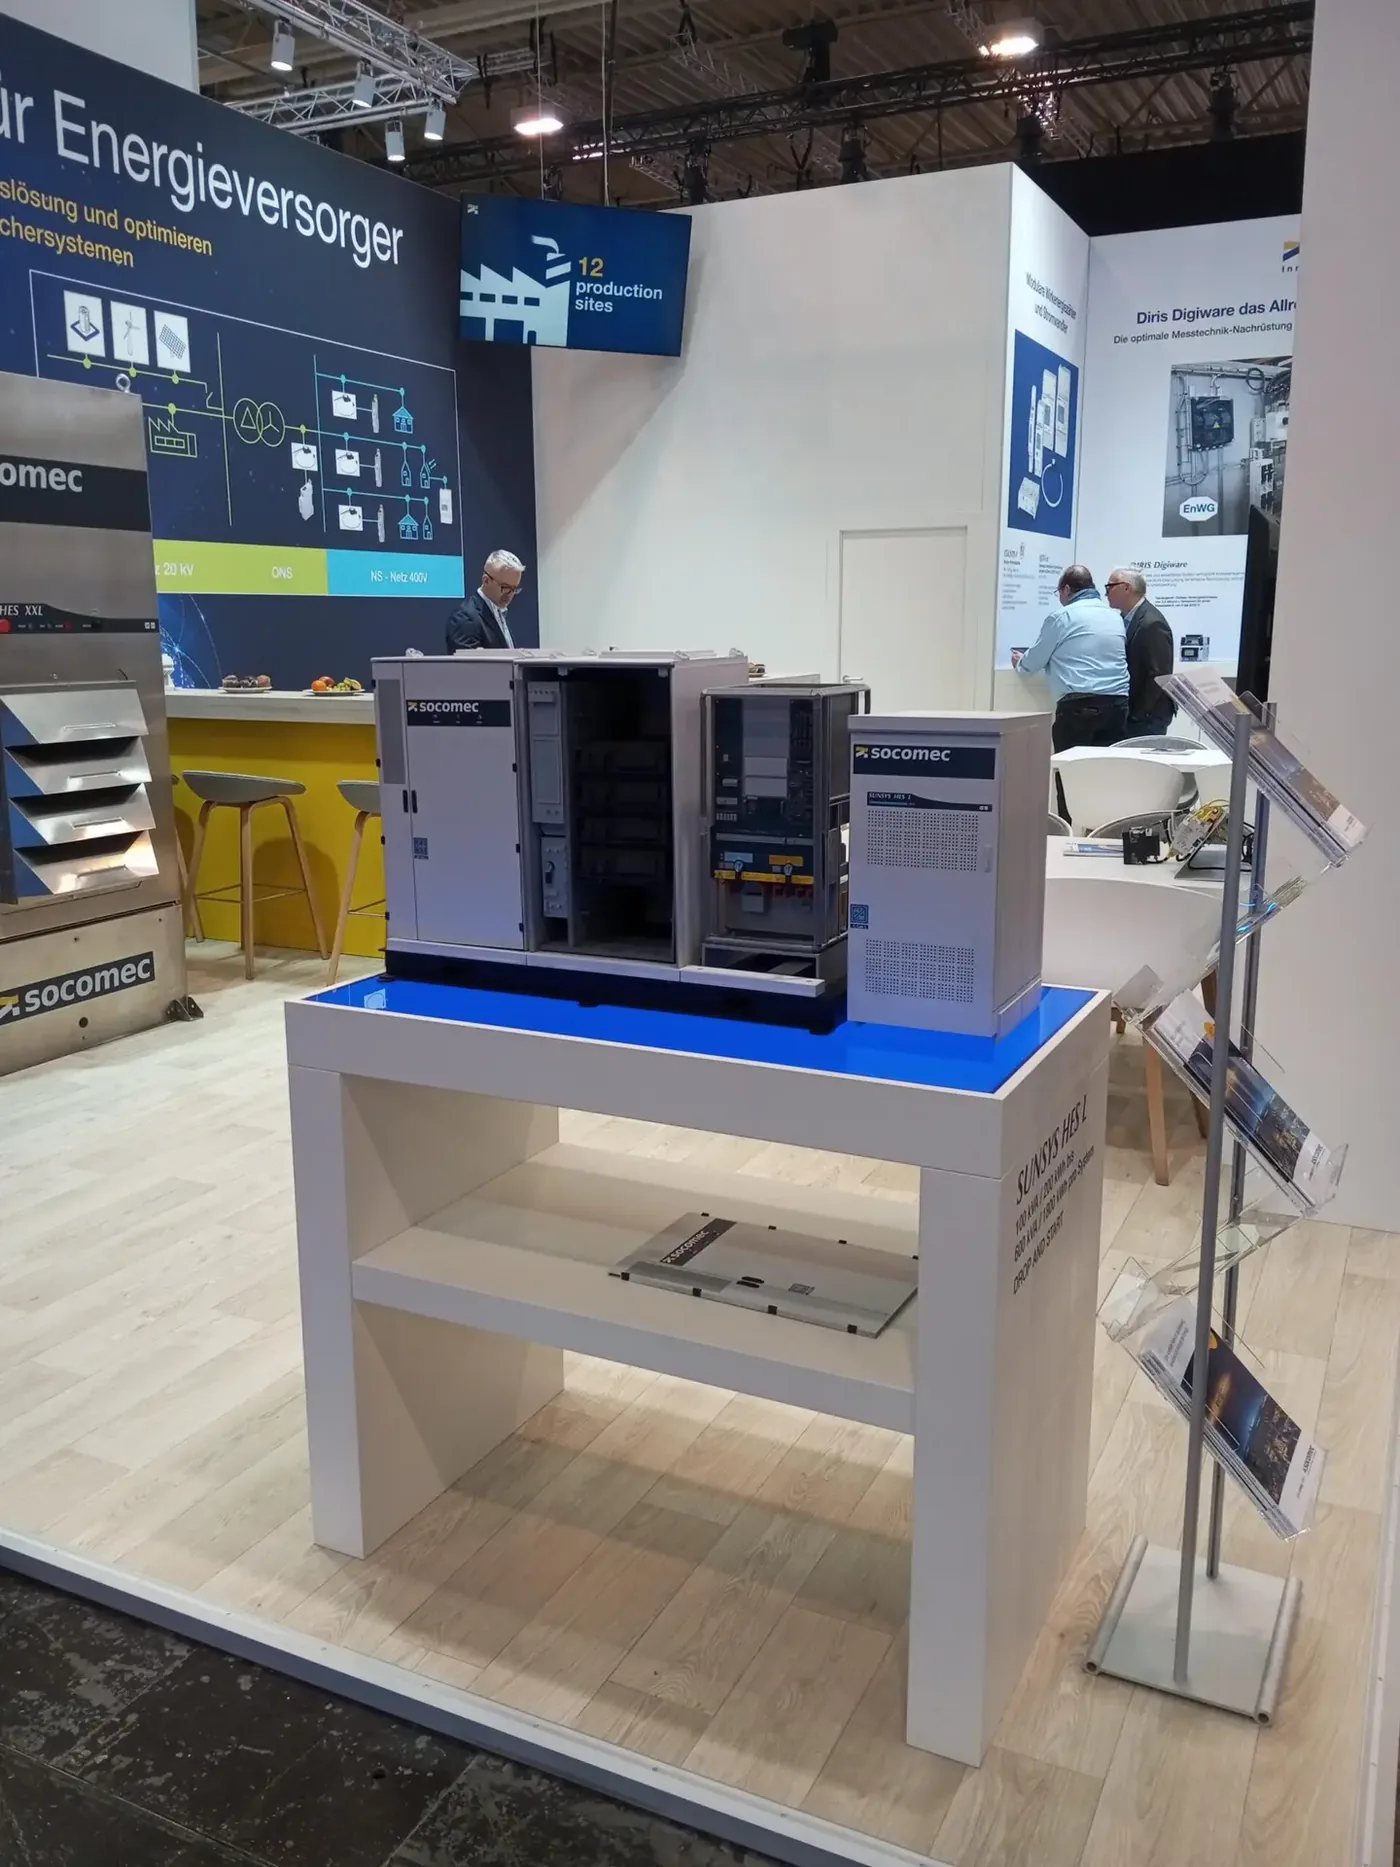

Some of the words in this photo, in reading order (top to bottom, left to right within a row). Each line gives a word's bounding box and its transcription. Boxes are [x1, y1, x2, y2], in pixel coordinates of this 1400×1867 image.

[54, 90, 403, 268] Energieversorger
[84, 204, 119, 230] und
[124, 217, 213, 256] optimieren
[578, 256, 604, 278] 12
[575, 281, 663, 300] production
[575, 298, 613, 313] sites
[1137, 312, 1168, 324] Diris
[1172, 307, 1235, 322] Digiware
[1239, 302, 1265, 315] das
[1113, 335, 1129, 344] Die
[1130, 331, 1169, 344] optimale
[1171, 322, 1293, 339] Messtechnik-Nachrüstung
[1183, 503, 1215, 514] EnWG
[164, 562, 177, 576] 20
[180, 563, 194, 576] kV
[272, 566, 293, 579] ONS
[1154, 560, 1188, 570] Digiware
[371, 570, 383, 582] NS
[390, 571, 408, 582] Netz
[409, 571, 428, 583] 400V
[25, 605, 43, 616] XXL
[419, 702, 479, 713] socomec
[871, 747, 951, 761] socomec
[25, 959, 151, 1013] socomec
[1016, 1127, 1060, 1205] SUNSYS
[1061, 1101, 1081, 1148] HES
[669, 1230, 709, 1260] socomec
[1013, 1257, 1032, 1295] DROP
[1032, 1237, 1046, 1268] AND
[1046, 1210, 1064, 1247] START
